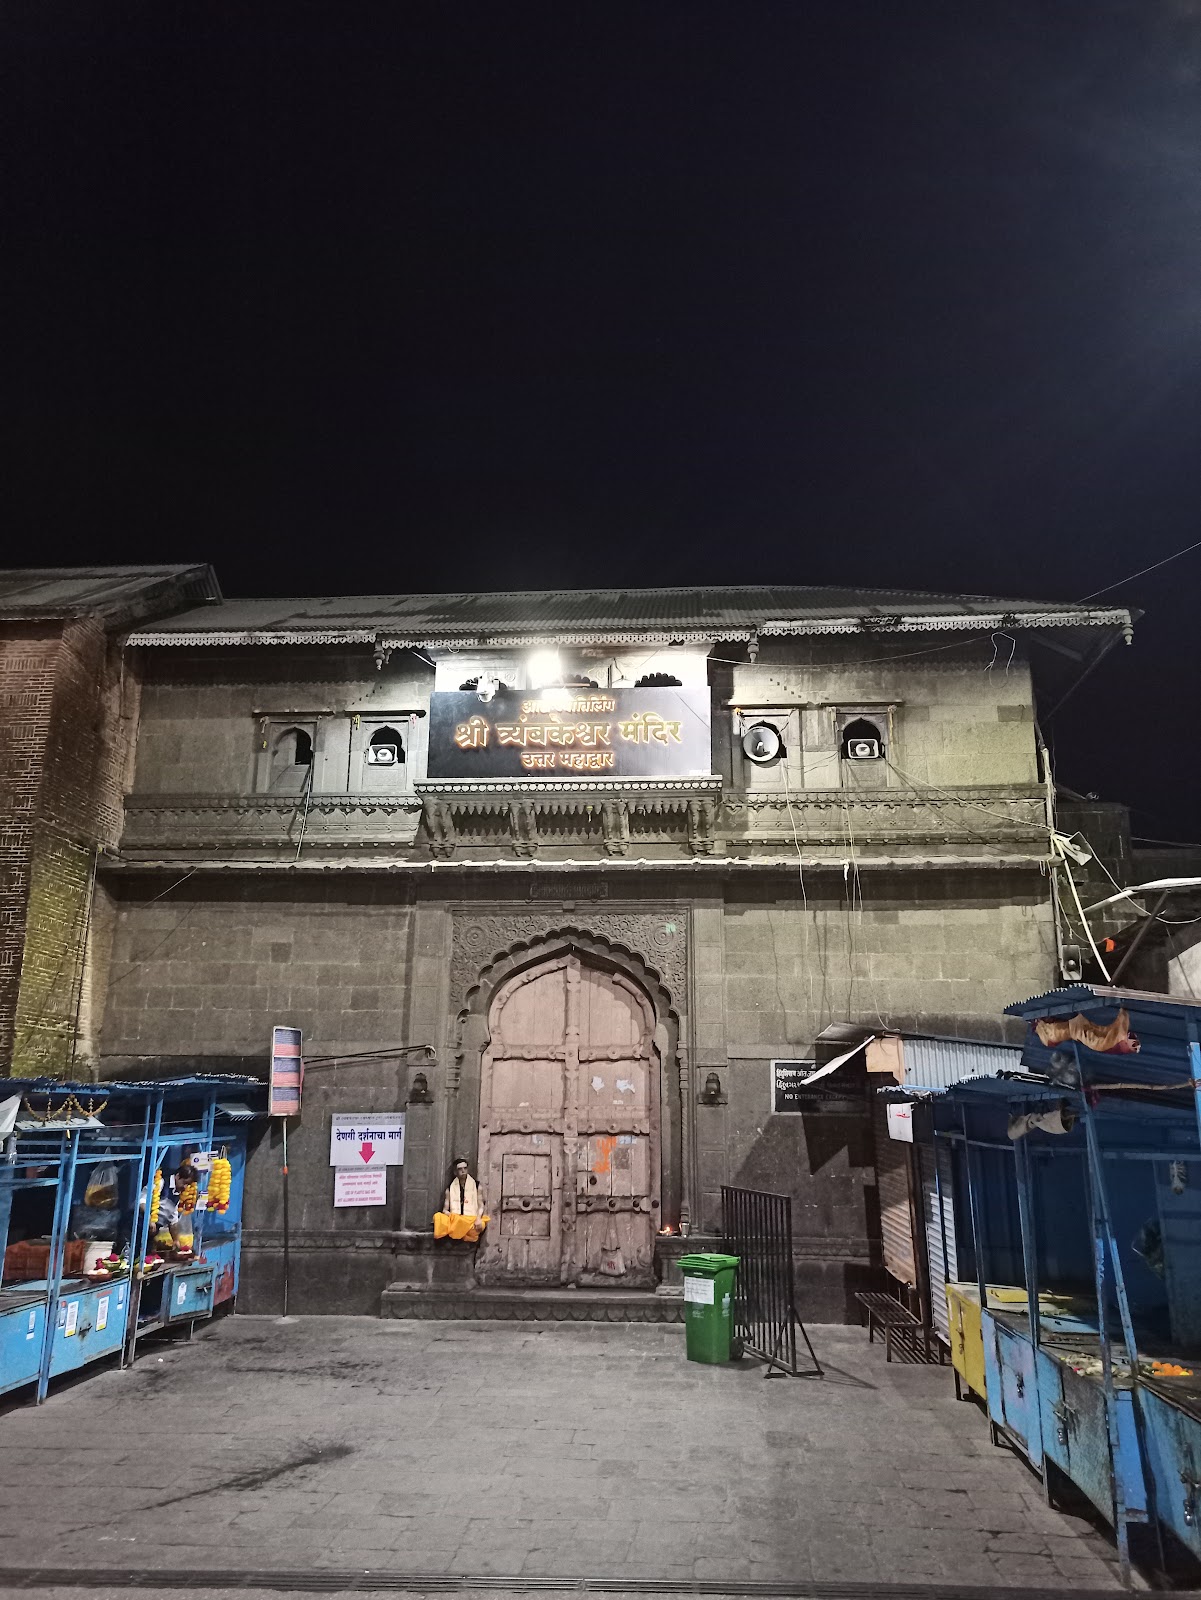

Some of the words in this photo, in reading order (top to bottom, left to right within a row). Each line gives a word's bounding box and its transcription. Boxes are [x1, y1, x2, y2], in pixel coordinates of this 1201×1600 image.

[455, 716, 489, 748] श्री
[495, 714, 611, 747] त्र्यंबकेश्वर
[618, 712, 682, 745] मंदिर
[521, 751, 555, 767] उत्तर
[559, 751, 614, 768] महाद्वार
[336, 1128, 356, 1141] देणगी
[358, 1128, 386, 1141] दर्शनाचा
[388, 1127, 402, 1140] मार्ग
